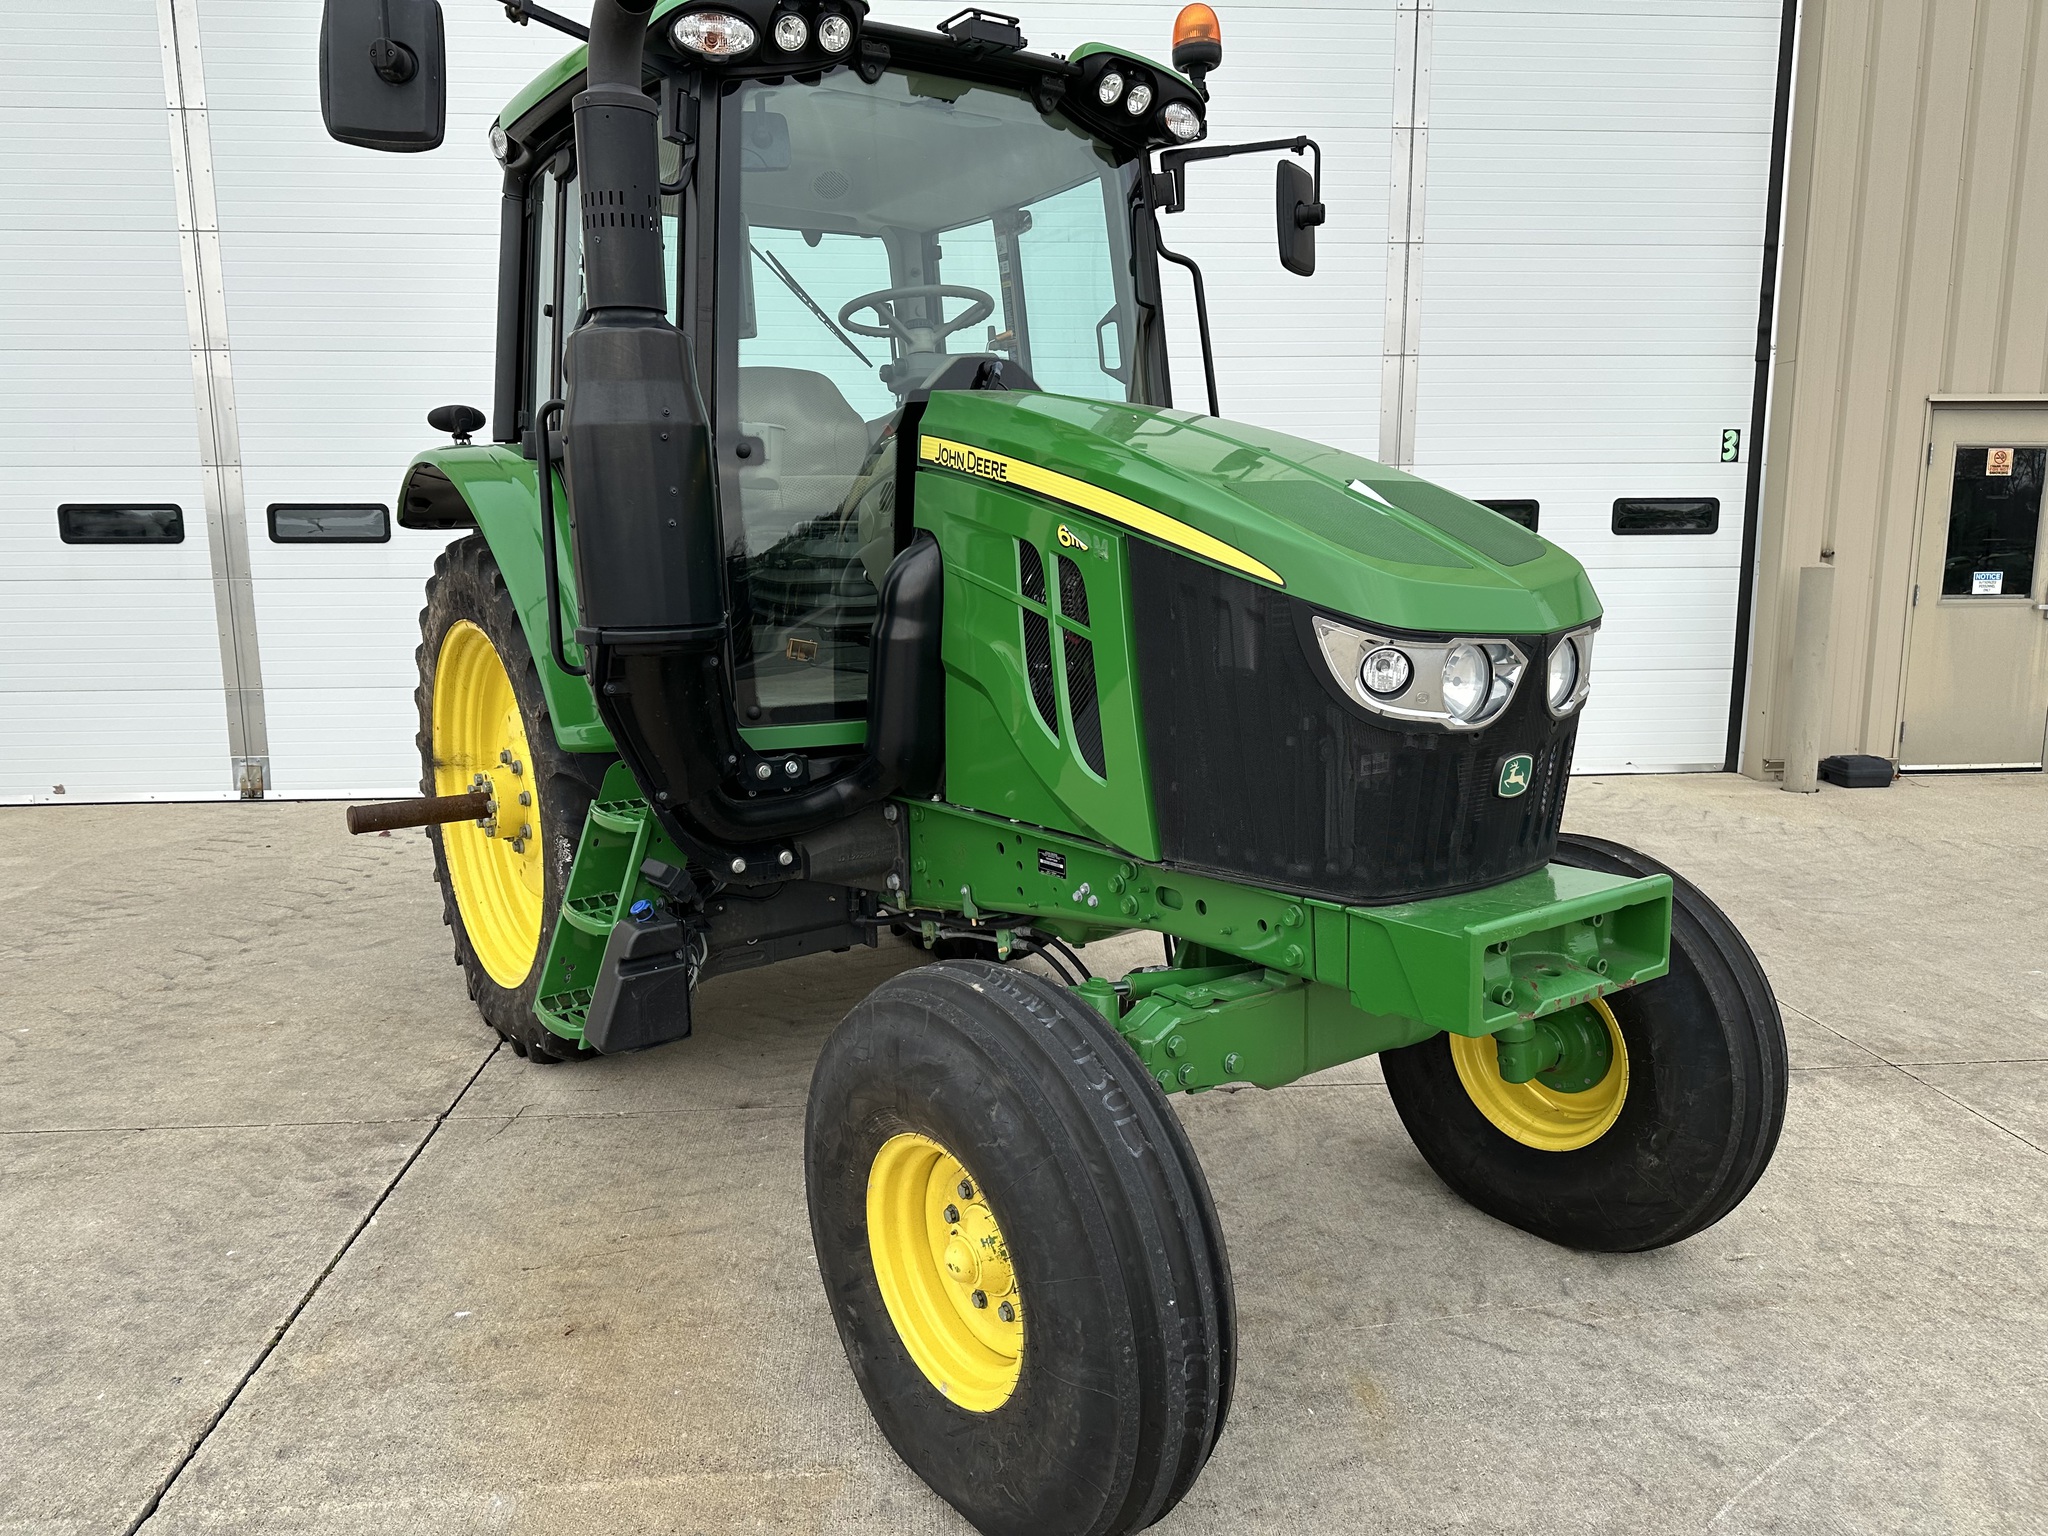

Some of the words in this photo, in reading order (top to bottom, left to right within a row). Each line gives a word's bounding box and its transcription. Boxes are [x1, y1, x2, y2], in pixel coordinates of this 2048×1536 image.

[934, 443, 965, 470] JOHN
[966, 450, 1008, 480] DEERE
[1722, 429, 1739, 461] 3
